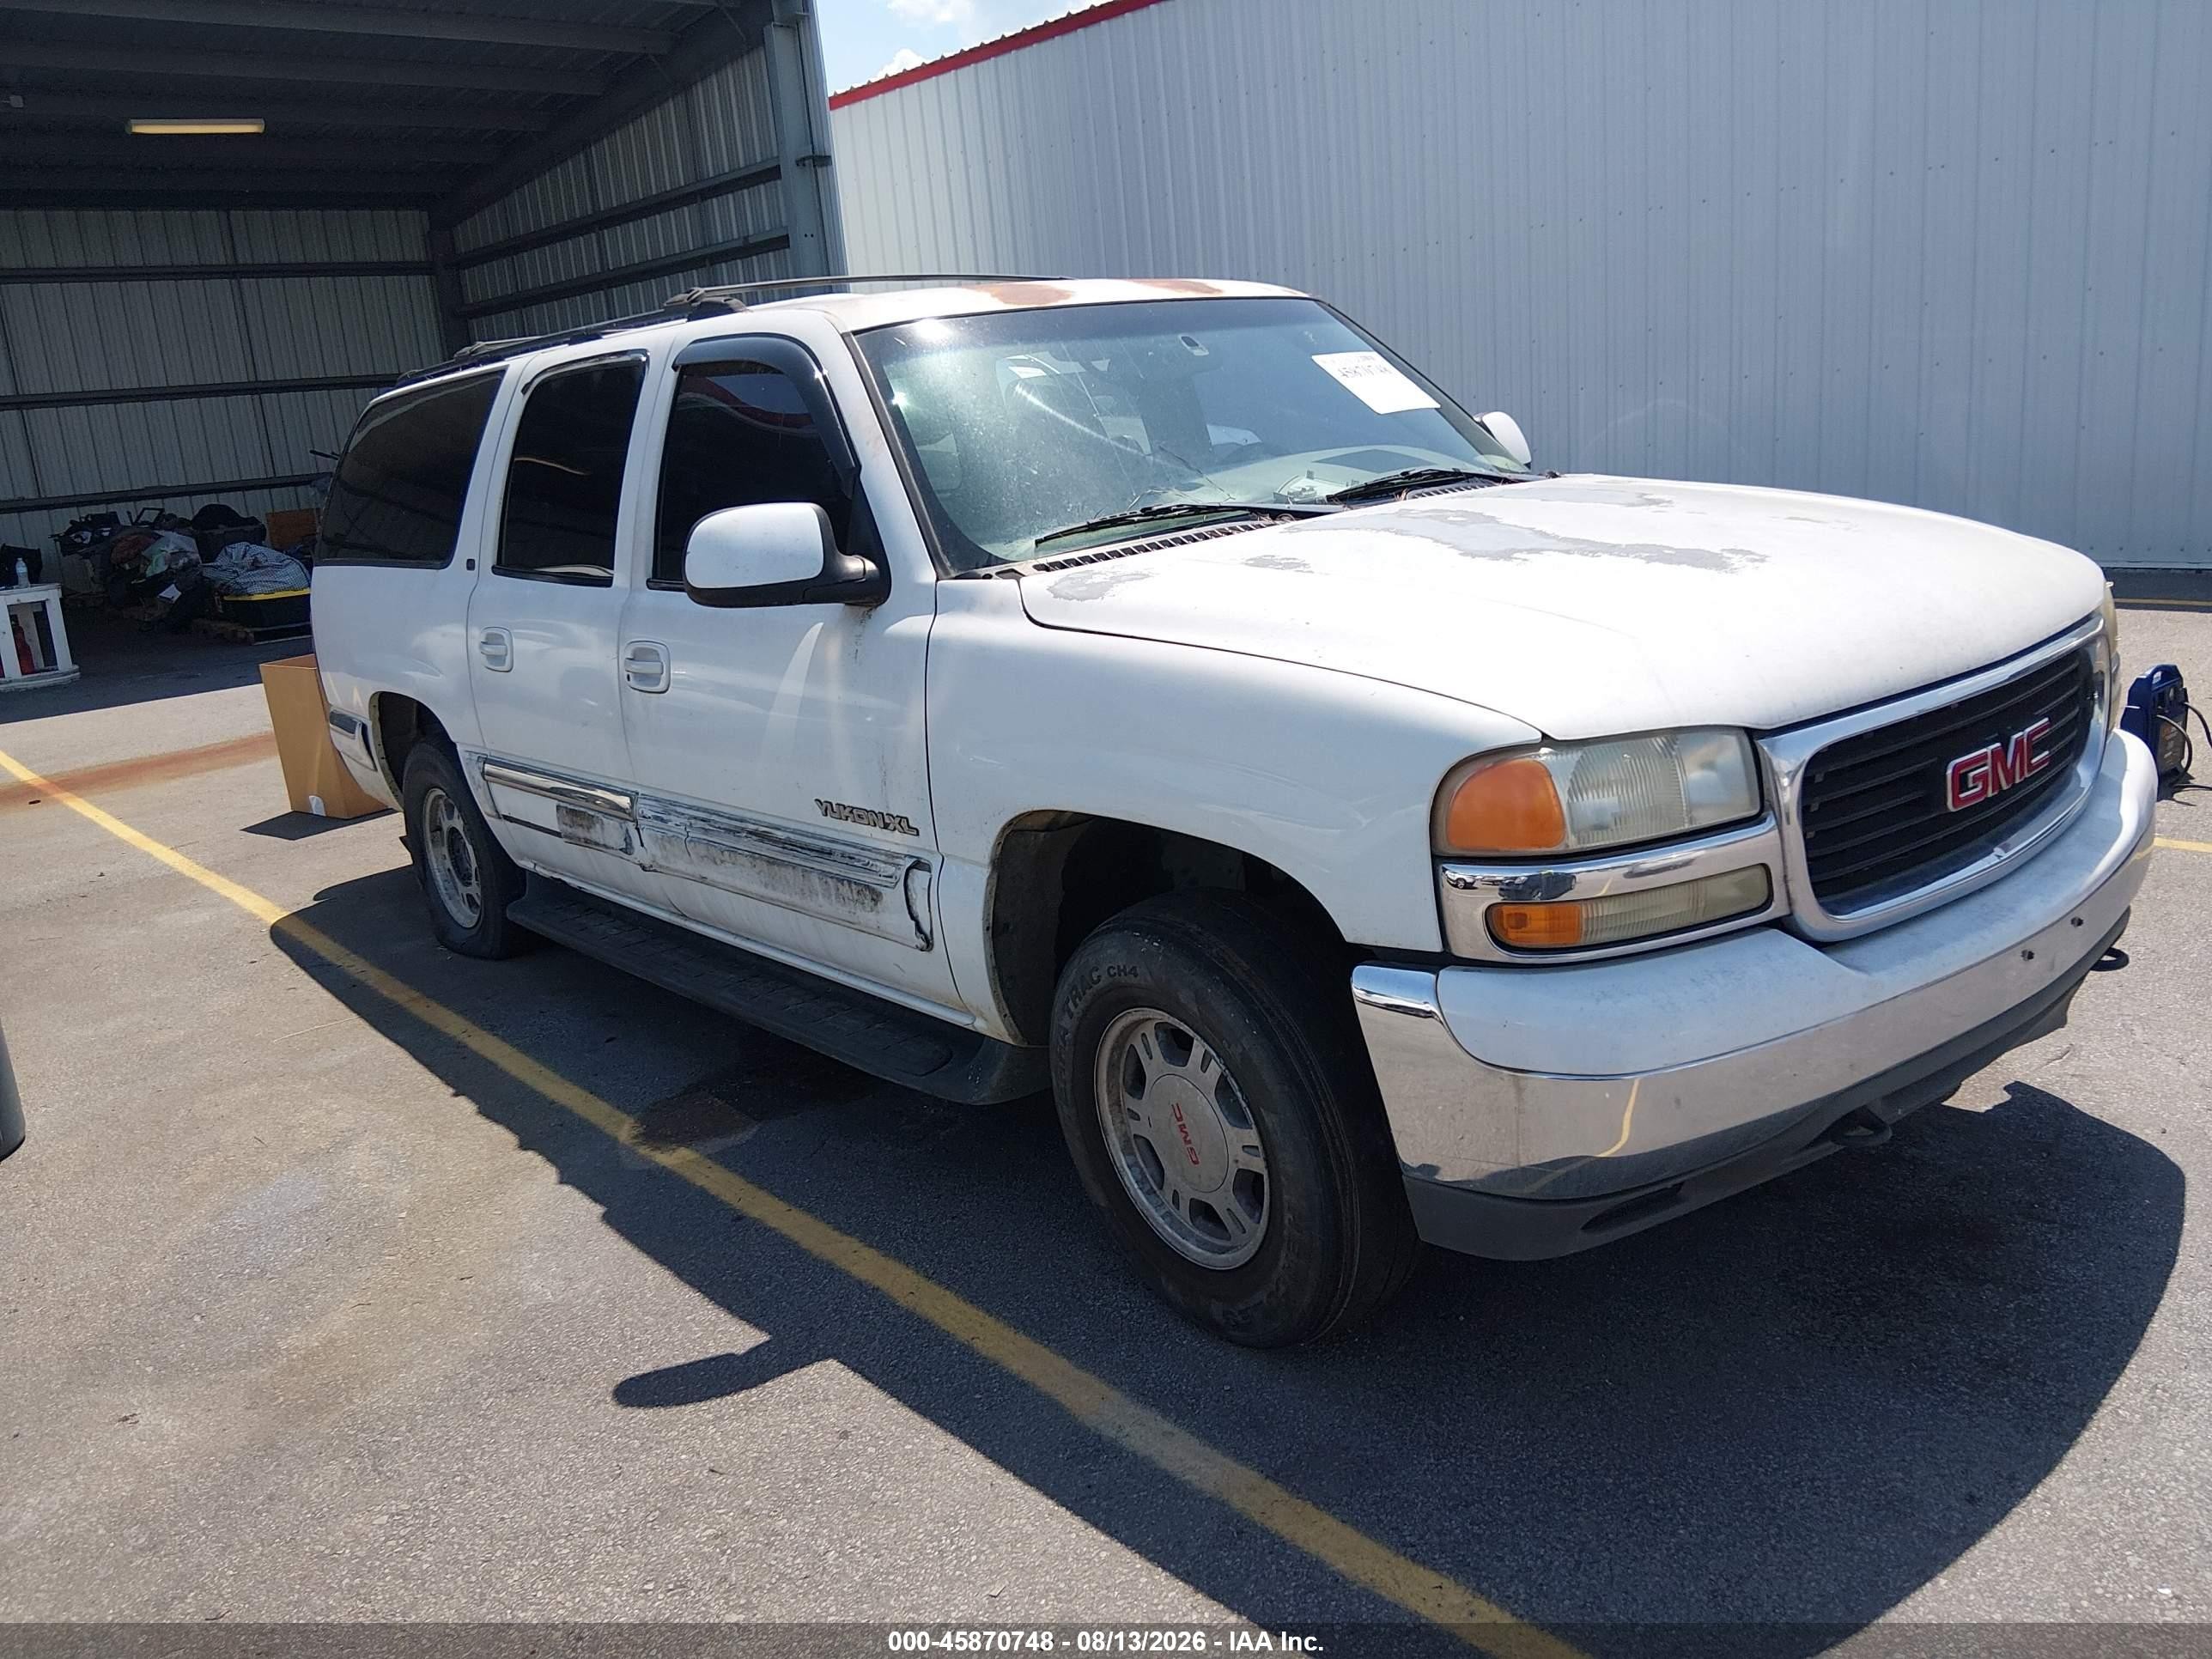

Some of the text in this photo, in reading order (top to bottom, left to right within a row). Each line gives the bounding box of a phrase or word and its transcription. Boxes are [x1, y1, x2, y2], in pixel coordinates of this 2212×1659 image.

[1946, 717, 2051, 811] GMC
[814, 799, 920, 836] YUKON XL
[1062, 964, 1102, 1020] TRAC
[1106, 964, 1139, 979] CH4
[1170, 1102, 1200, 1165] GMC
